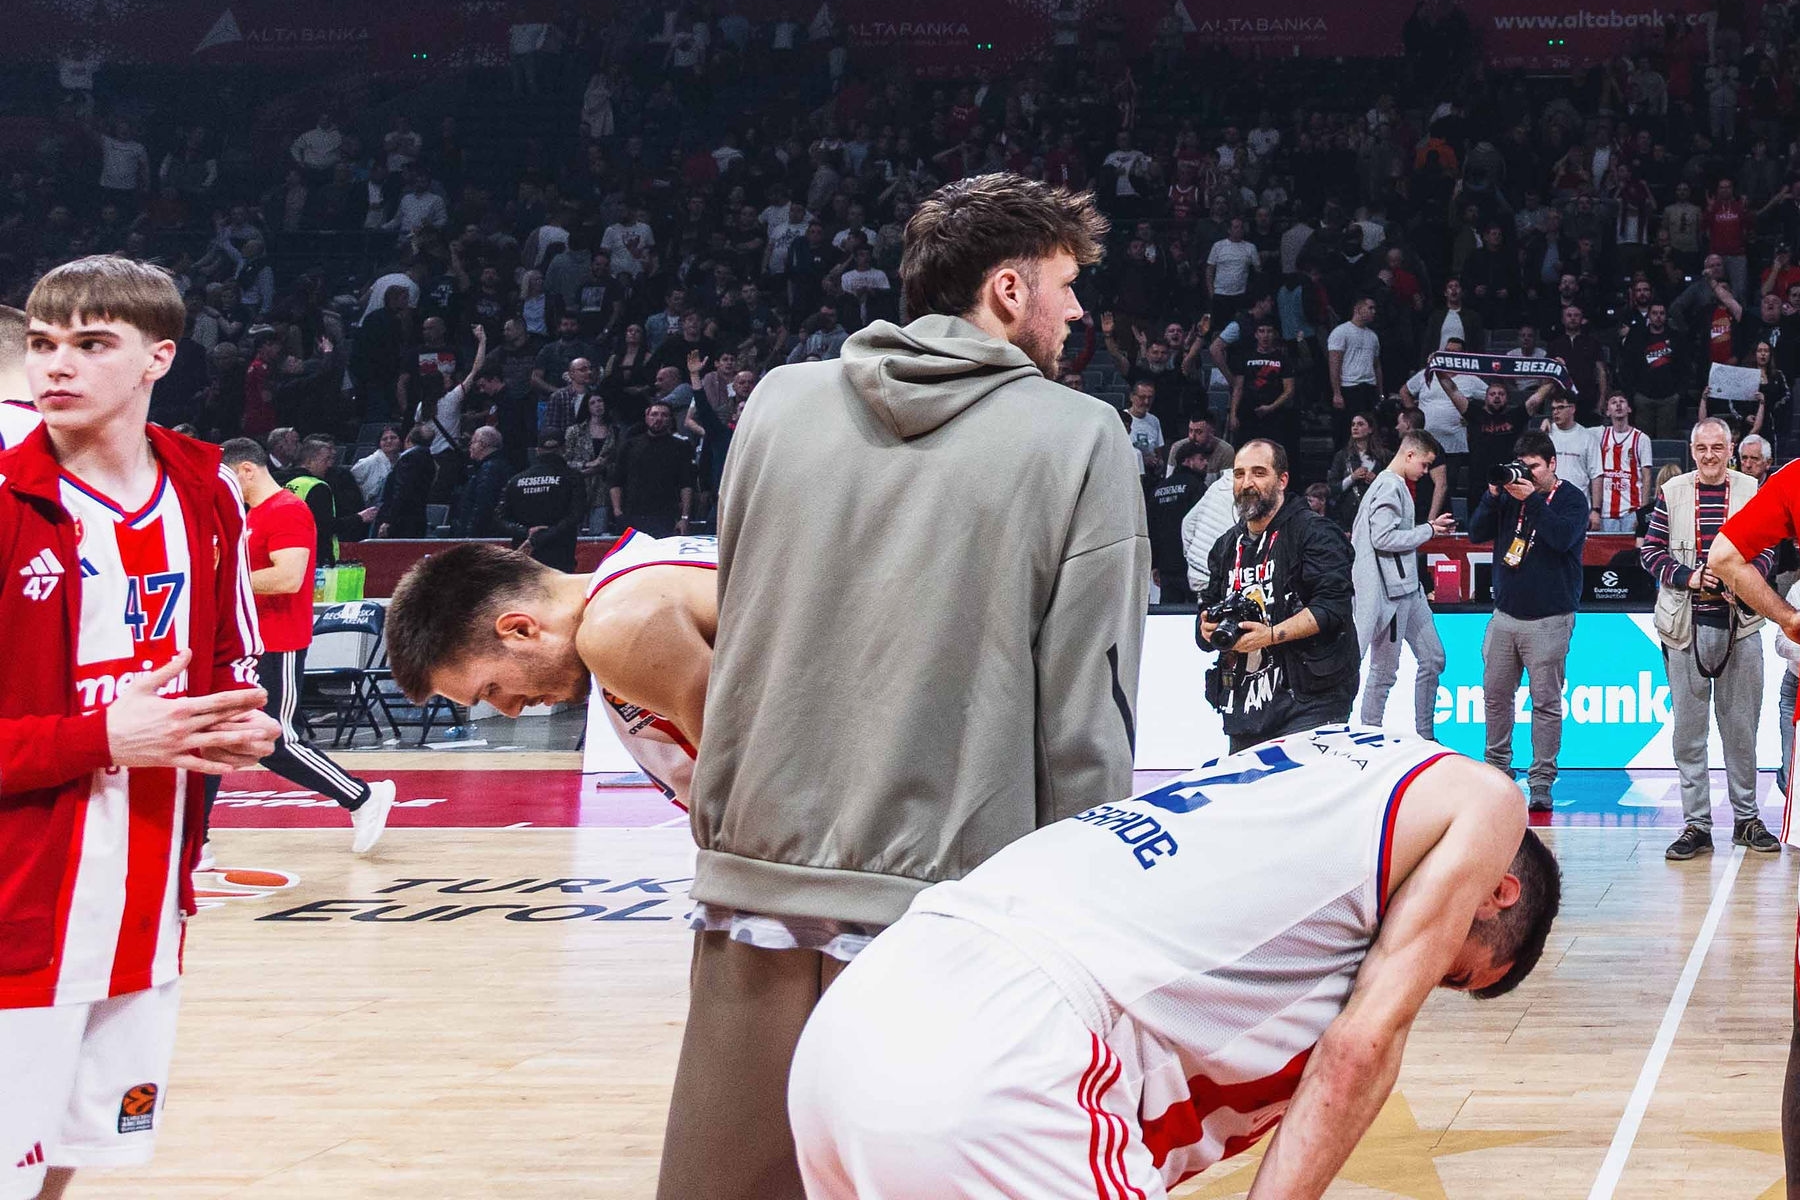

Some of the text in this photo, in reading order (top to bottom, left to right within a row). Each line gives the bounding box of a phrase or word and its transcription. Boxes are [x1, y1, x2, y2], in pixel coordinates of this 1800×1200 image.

[246, 27, 369, 42] ALTABANKA
[22, 576, 59, 601] 47
[124, 571, 186, 642] 47
